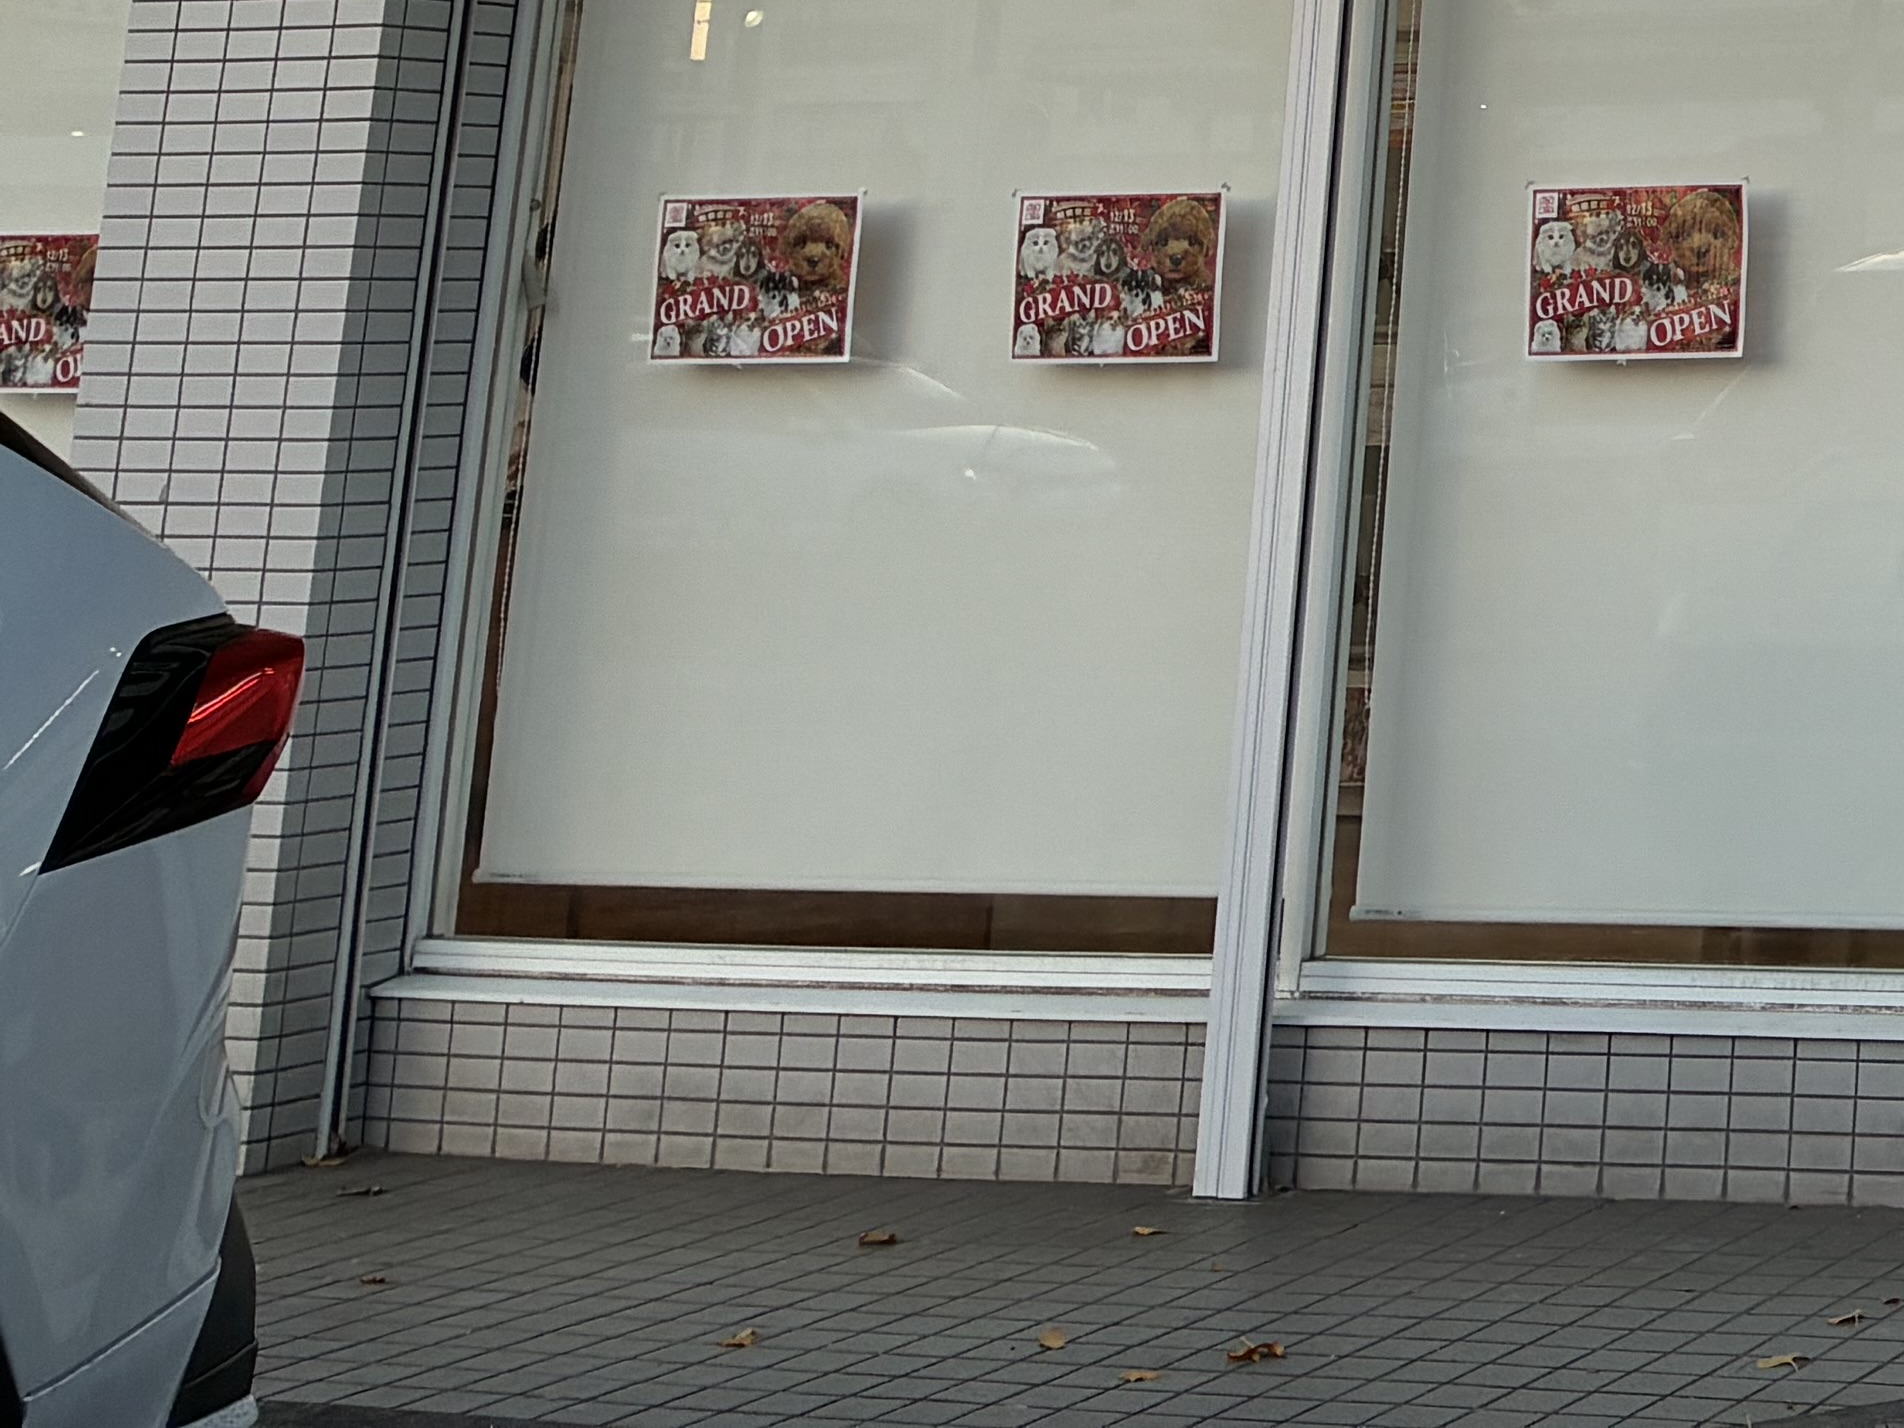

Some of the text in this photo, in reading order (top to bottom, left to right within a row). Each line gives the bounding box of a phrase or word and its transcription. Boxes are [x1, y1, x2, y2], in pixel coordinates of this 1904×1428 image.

[659, 285, 750, 324] GRAND
[1019, 282, 1112, 324] GRAND
[1535, 276, 1633, 320] GRAND
[762, 307, 839, 352] OPEN
[1126, 305, 1206, 352] OPEN
[1649, 300, 1732, 347] OPEN
